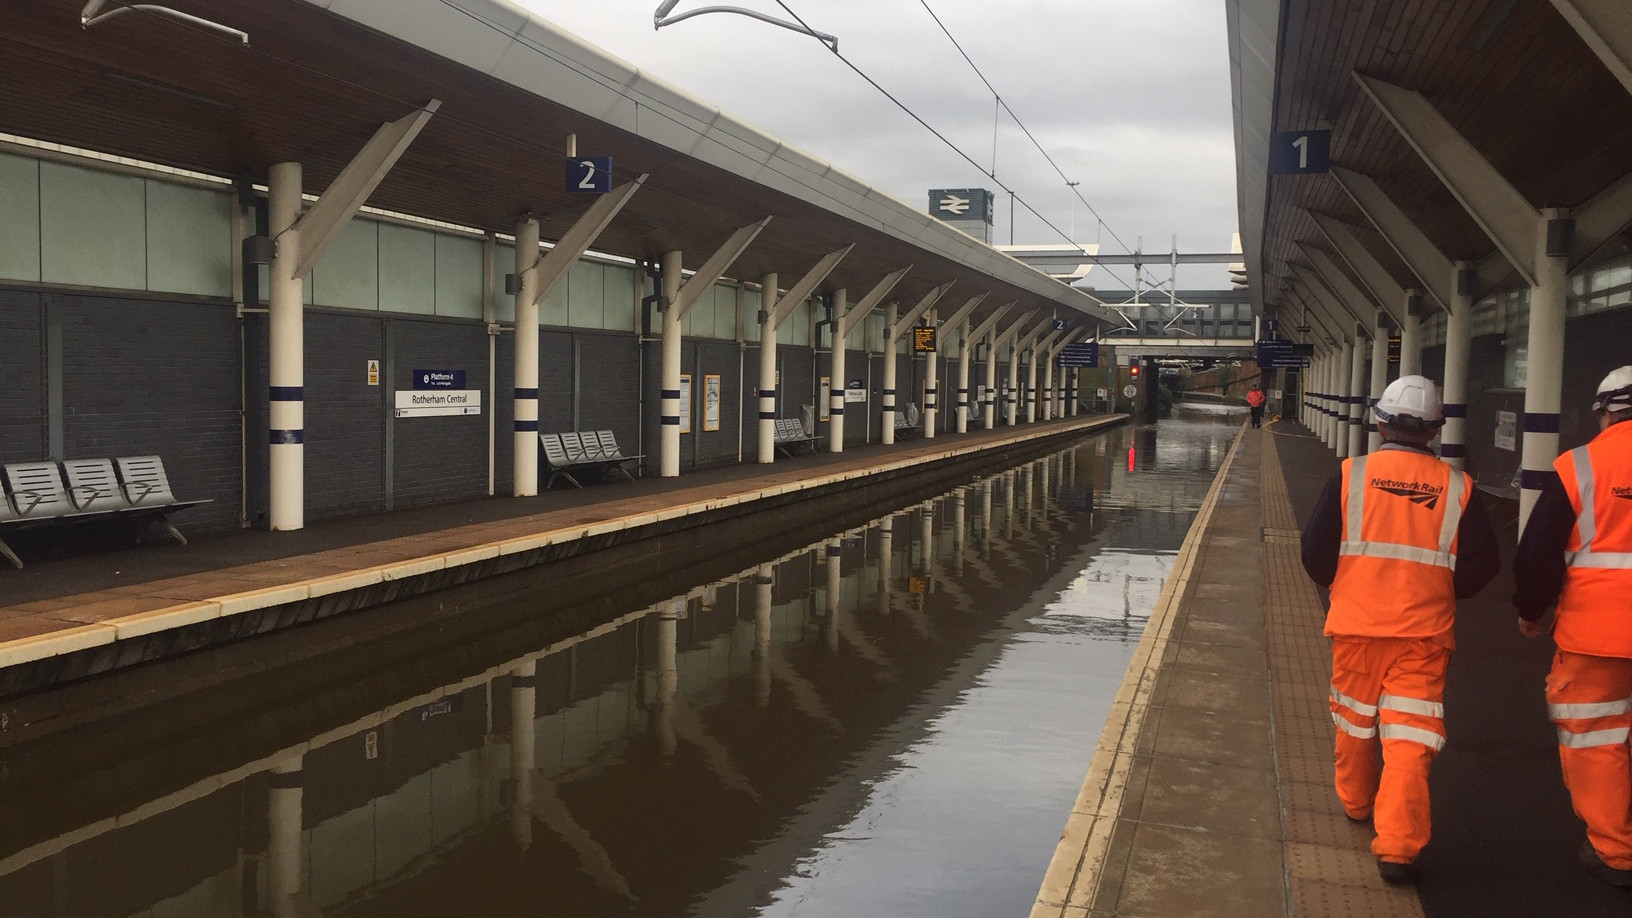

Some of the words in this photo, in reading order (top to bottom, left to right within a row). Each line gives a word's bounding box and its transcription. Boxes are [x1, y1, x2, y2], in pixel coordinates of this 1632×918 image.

[1292, 136, 1308, 168] 1
[579, 161, 595, 188] 2
[1056, 320, 1064, 330] 2
[1267, 320, 1273, 330] 1
[412, 394, 446, 404] Rotherham
[446, 393, 468, 403] Central
